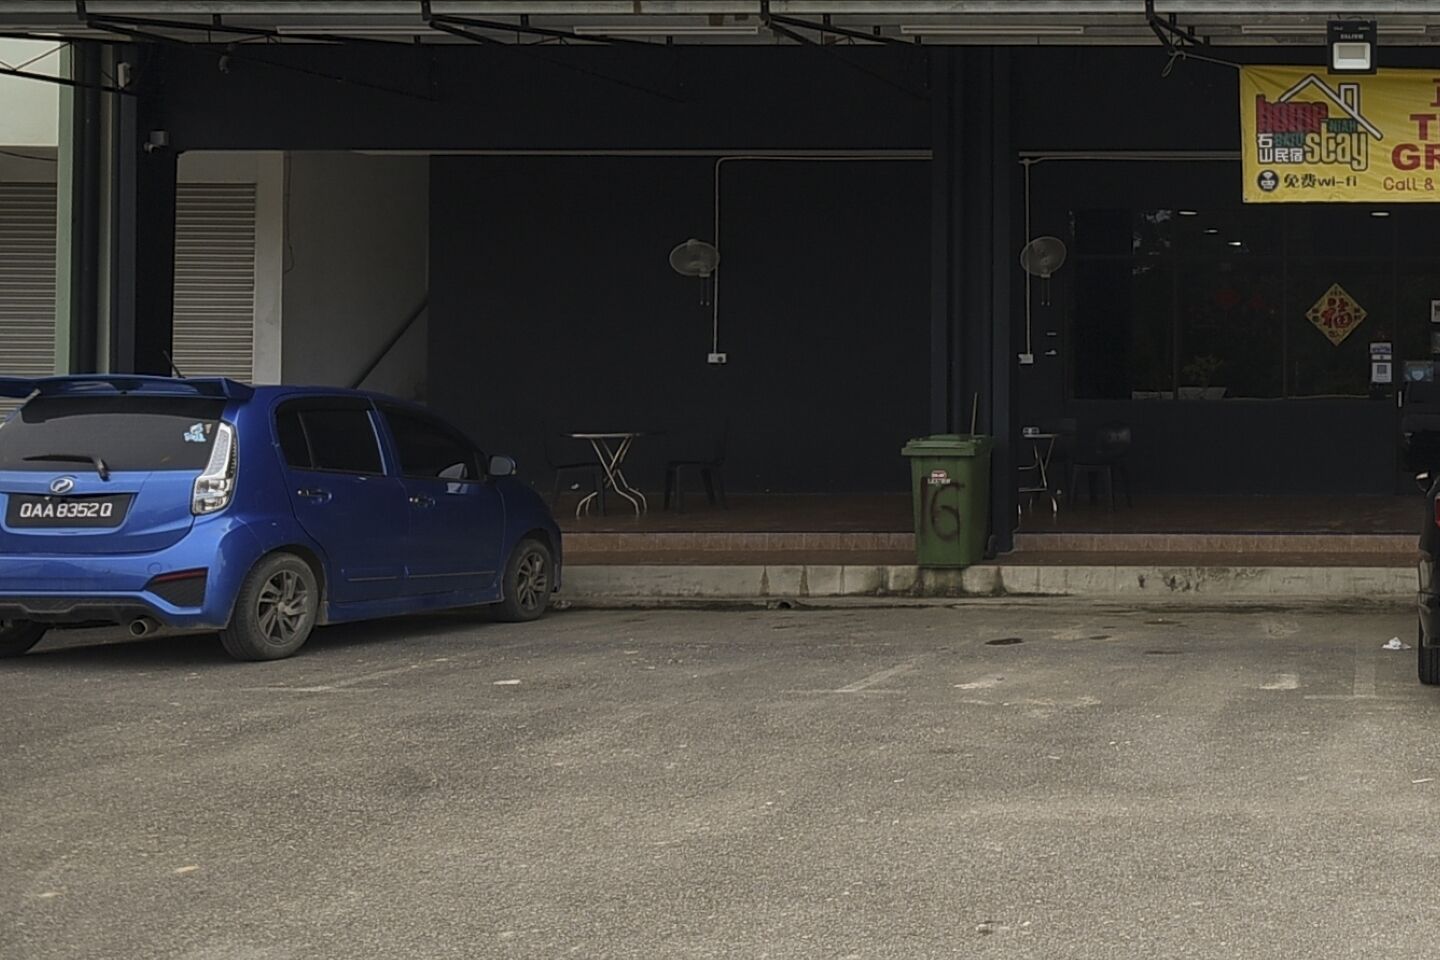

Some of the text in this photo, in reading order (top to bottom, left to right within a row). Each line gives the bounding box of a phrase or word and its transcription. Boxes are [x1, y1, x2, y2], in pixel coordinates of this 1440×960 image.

[1304, 119, 1368, 171] stay
[1383, 177, 1416, 190] Call
[1424, 177, 1435, 190] &
